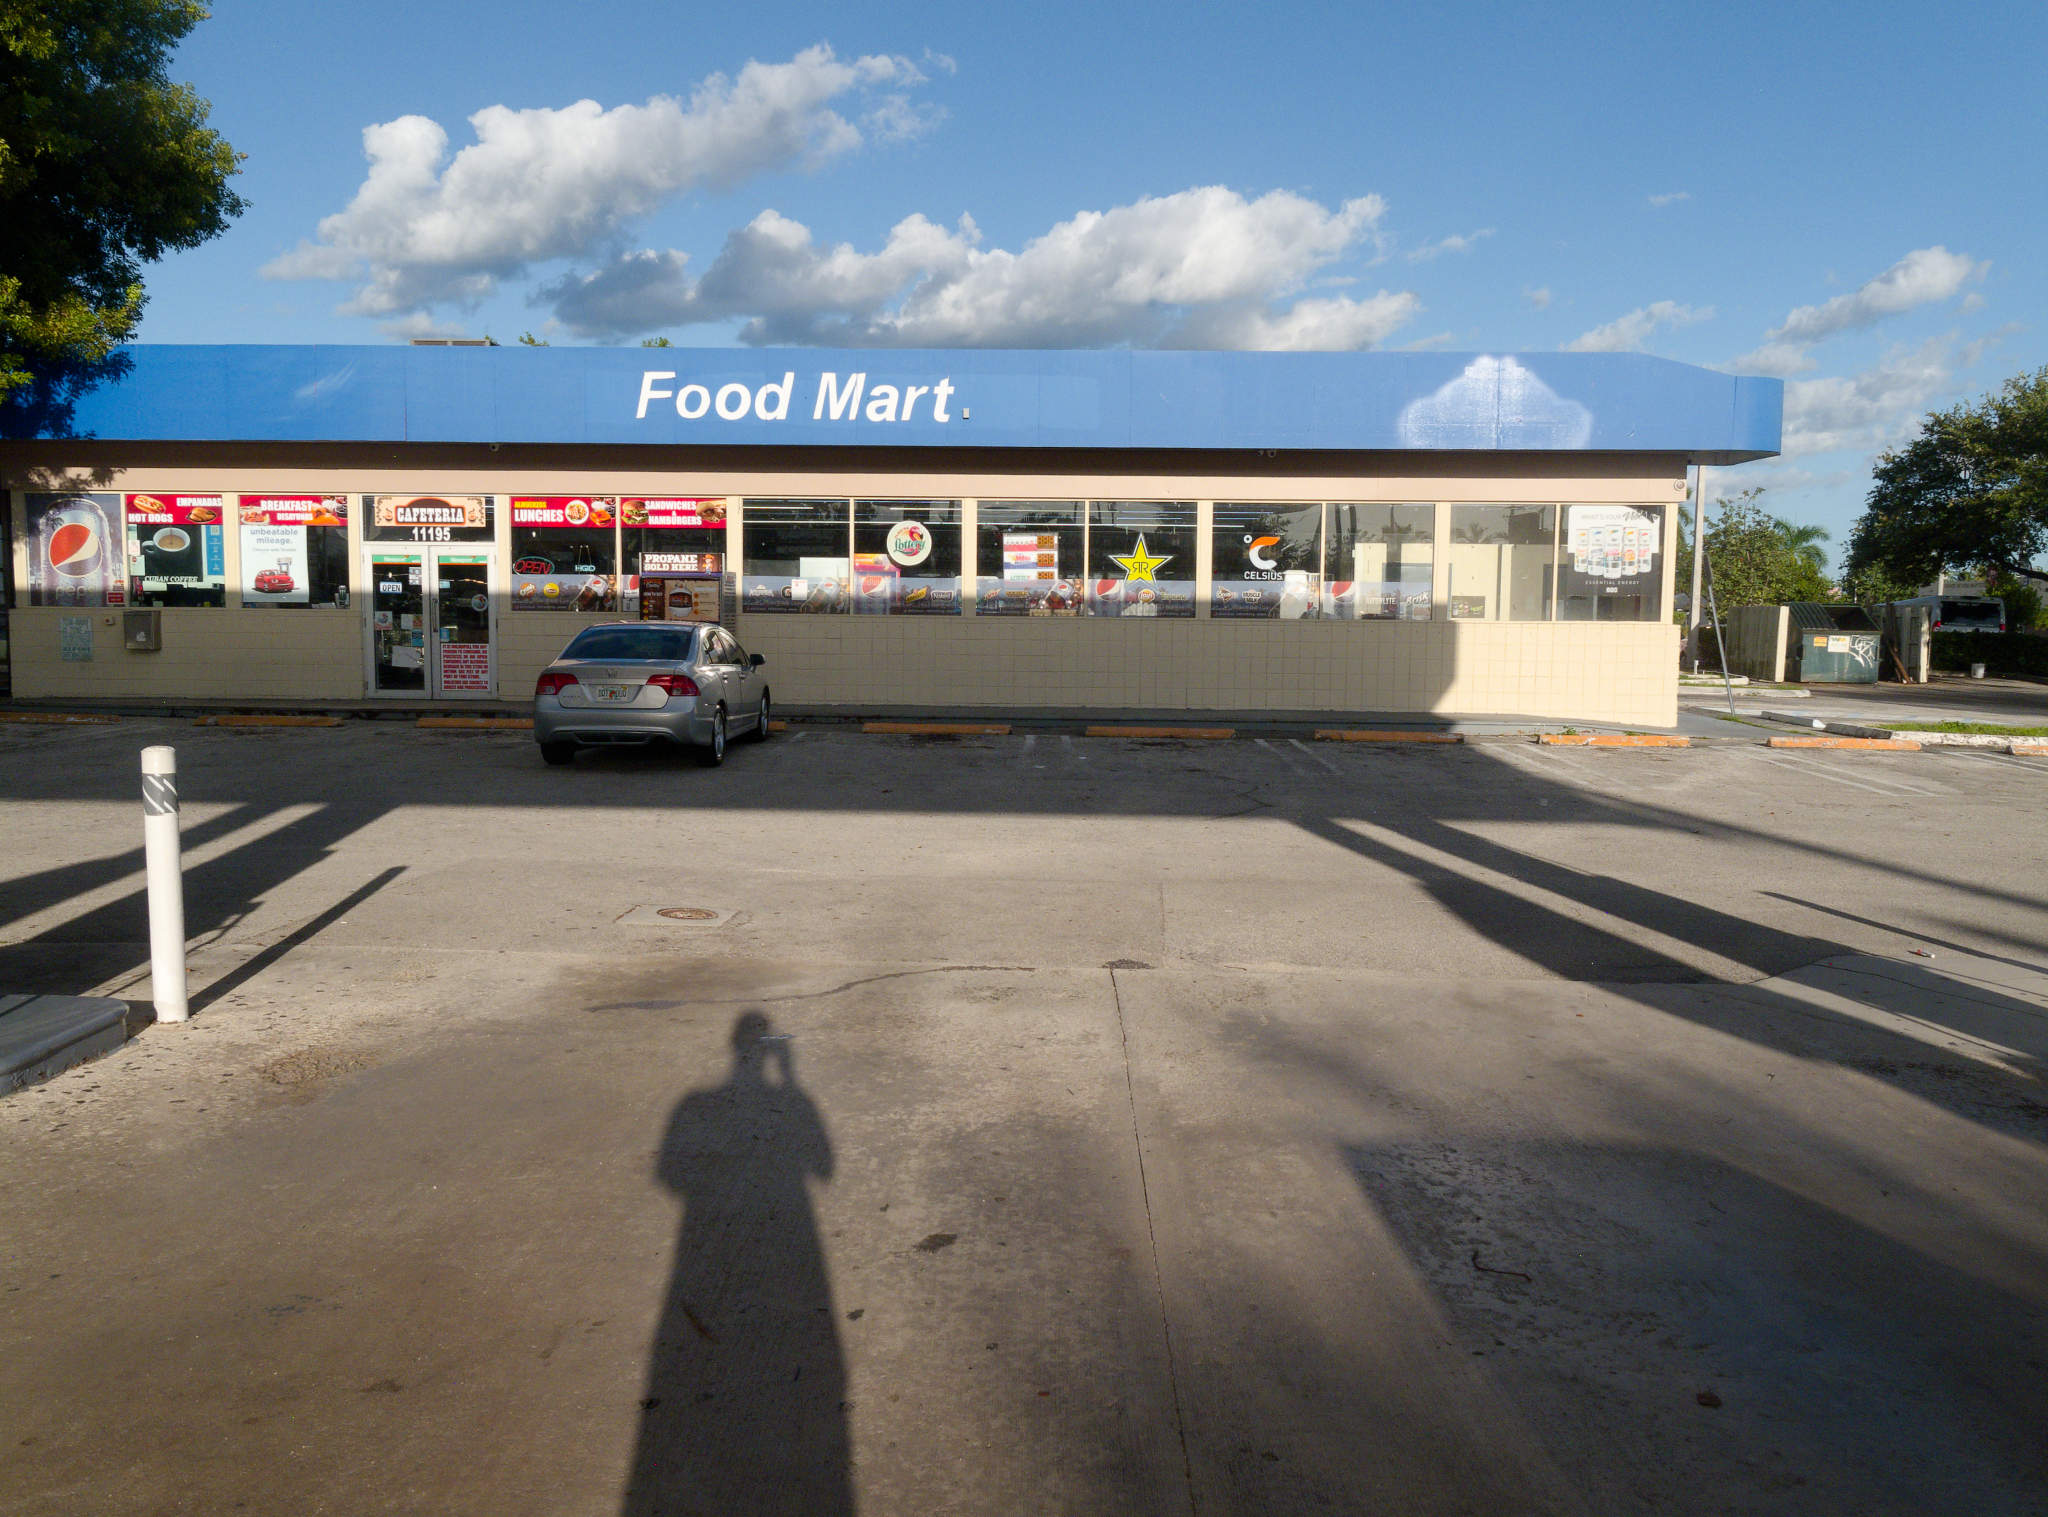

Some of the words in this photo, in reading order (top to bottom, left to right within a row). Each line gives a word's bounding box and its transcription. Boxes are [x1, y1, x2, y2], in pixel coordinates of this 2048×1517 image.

[636, 371, 795, 421] Food
[813, 372, 955, 423] Mart
[260, 500, 313, 511] BREAKFAST
[645, 501, 697, 510] SANDWICHES
[128, 513, 146, 523] HOT
[148, 513, 174, 523] DOGS
[397, 507, 464, 523] CAFETERIA
[514, 509, 564, 522] LUNCHES
[648, 515, 703, 525] HAMBURGERS
[250, 527, 299, 536] unbeatable
[412, 526, 451, 541] 11195
[644, 554, 698, 563] PROPANE
[515, 560, 552, 575] OPEN
[1244, 571, 1283, 580] CELSIUS
[382, 584, 401, 592] OPEN
